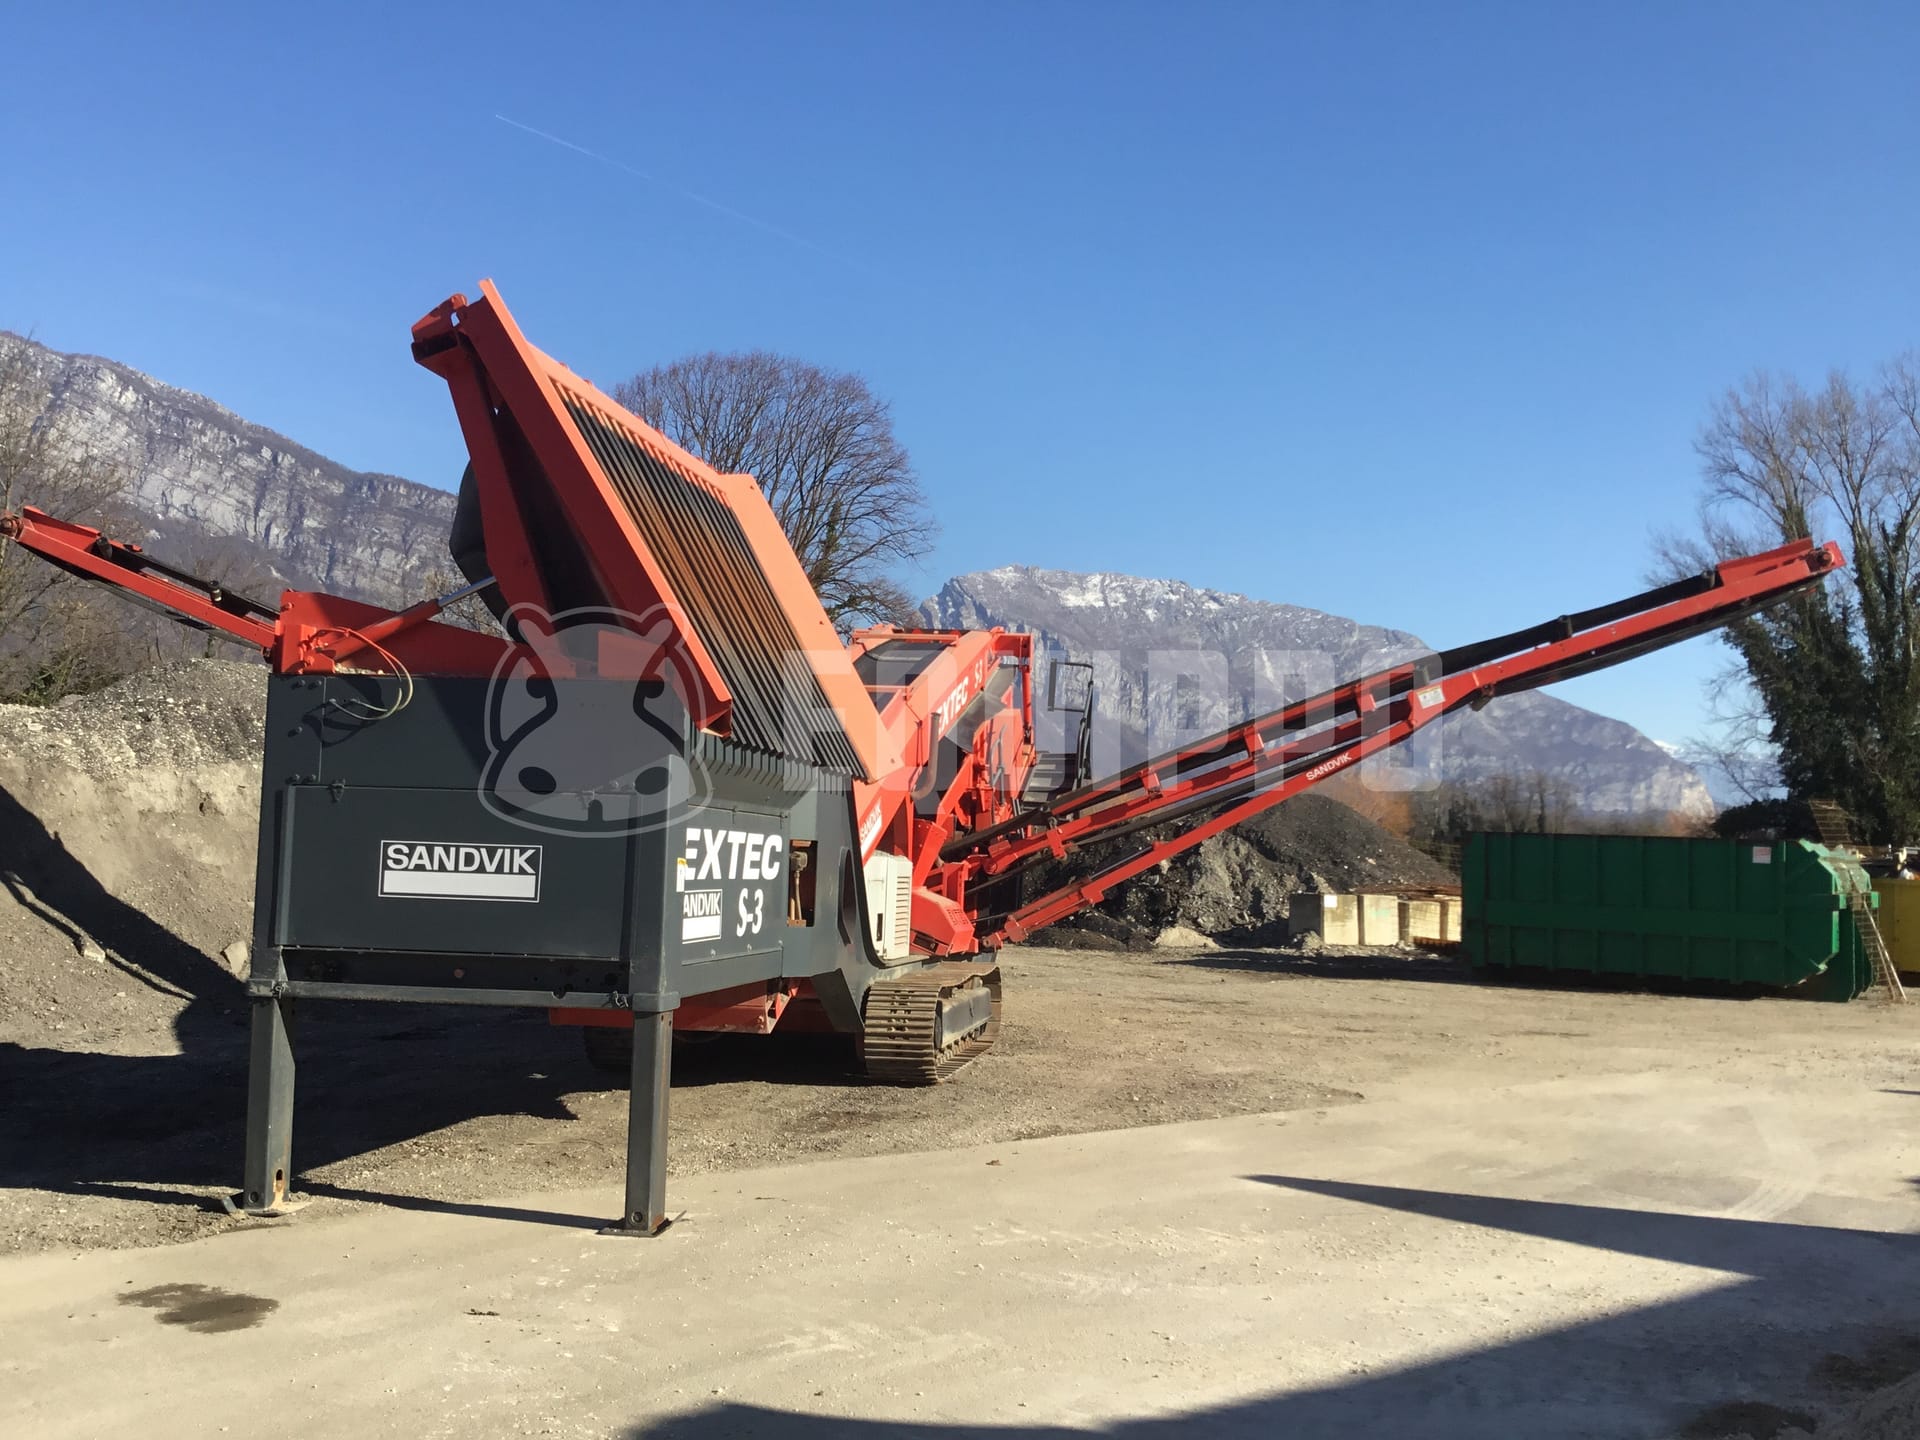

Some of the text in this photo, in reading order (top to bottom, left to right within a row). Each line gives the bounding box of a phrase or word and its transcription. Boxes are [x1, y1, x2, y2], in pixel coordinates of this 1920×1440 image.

[1305, 752, 1353, 781] SANDVIK
[386, 844, 536, 874] SANDVIK
[685, 827, 782, 881] EXTEC
[683, 892, 721, 917] ANDVIK
[736, 887, 764, 937] S-3
